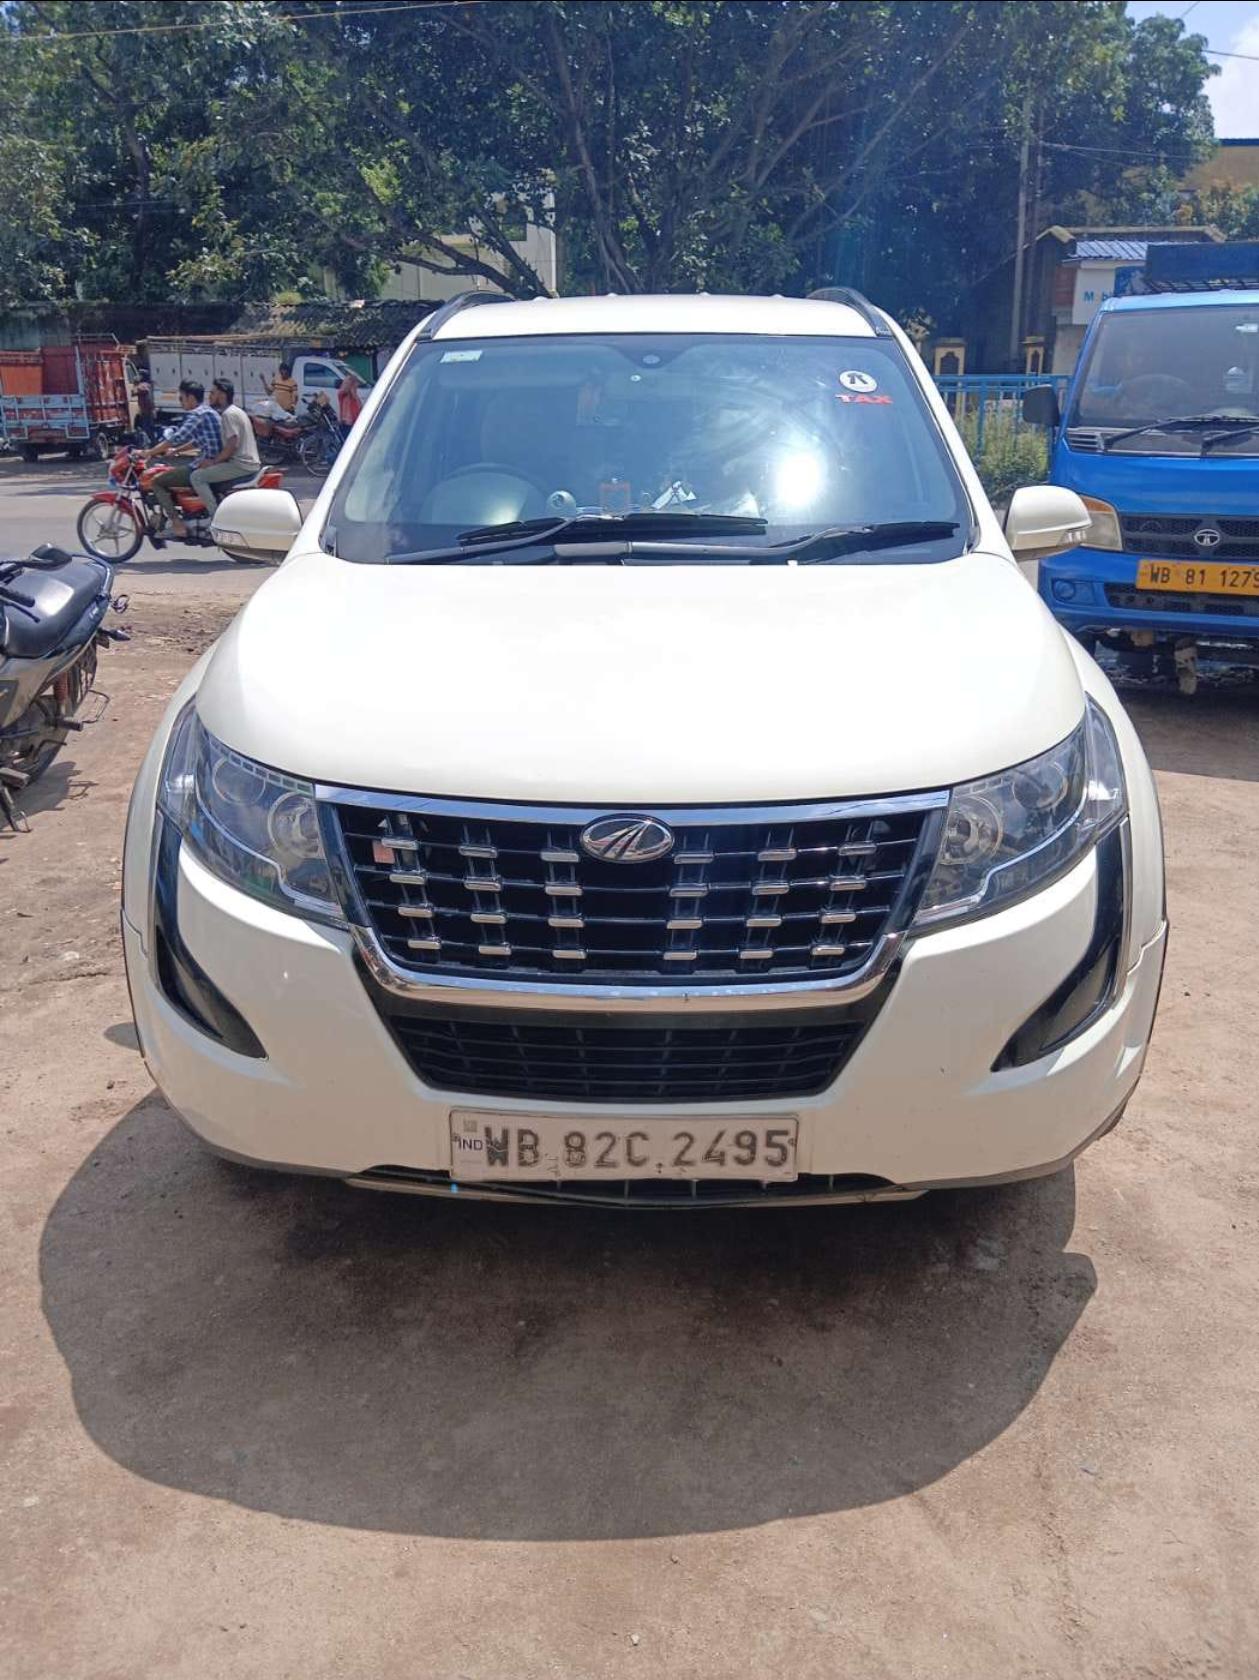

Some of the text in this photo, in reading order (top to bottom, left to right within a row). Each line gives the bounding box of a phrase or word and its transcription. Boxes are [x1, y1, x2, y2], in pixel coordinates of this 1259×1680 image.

[1149, 563, 1171, 584] WB
[1185, 568, 1207, 585] 81
[458, 1138, 484, 1151] IND
[484, 1126, 790, 1169] WB 82C 2495
